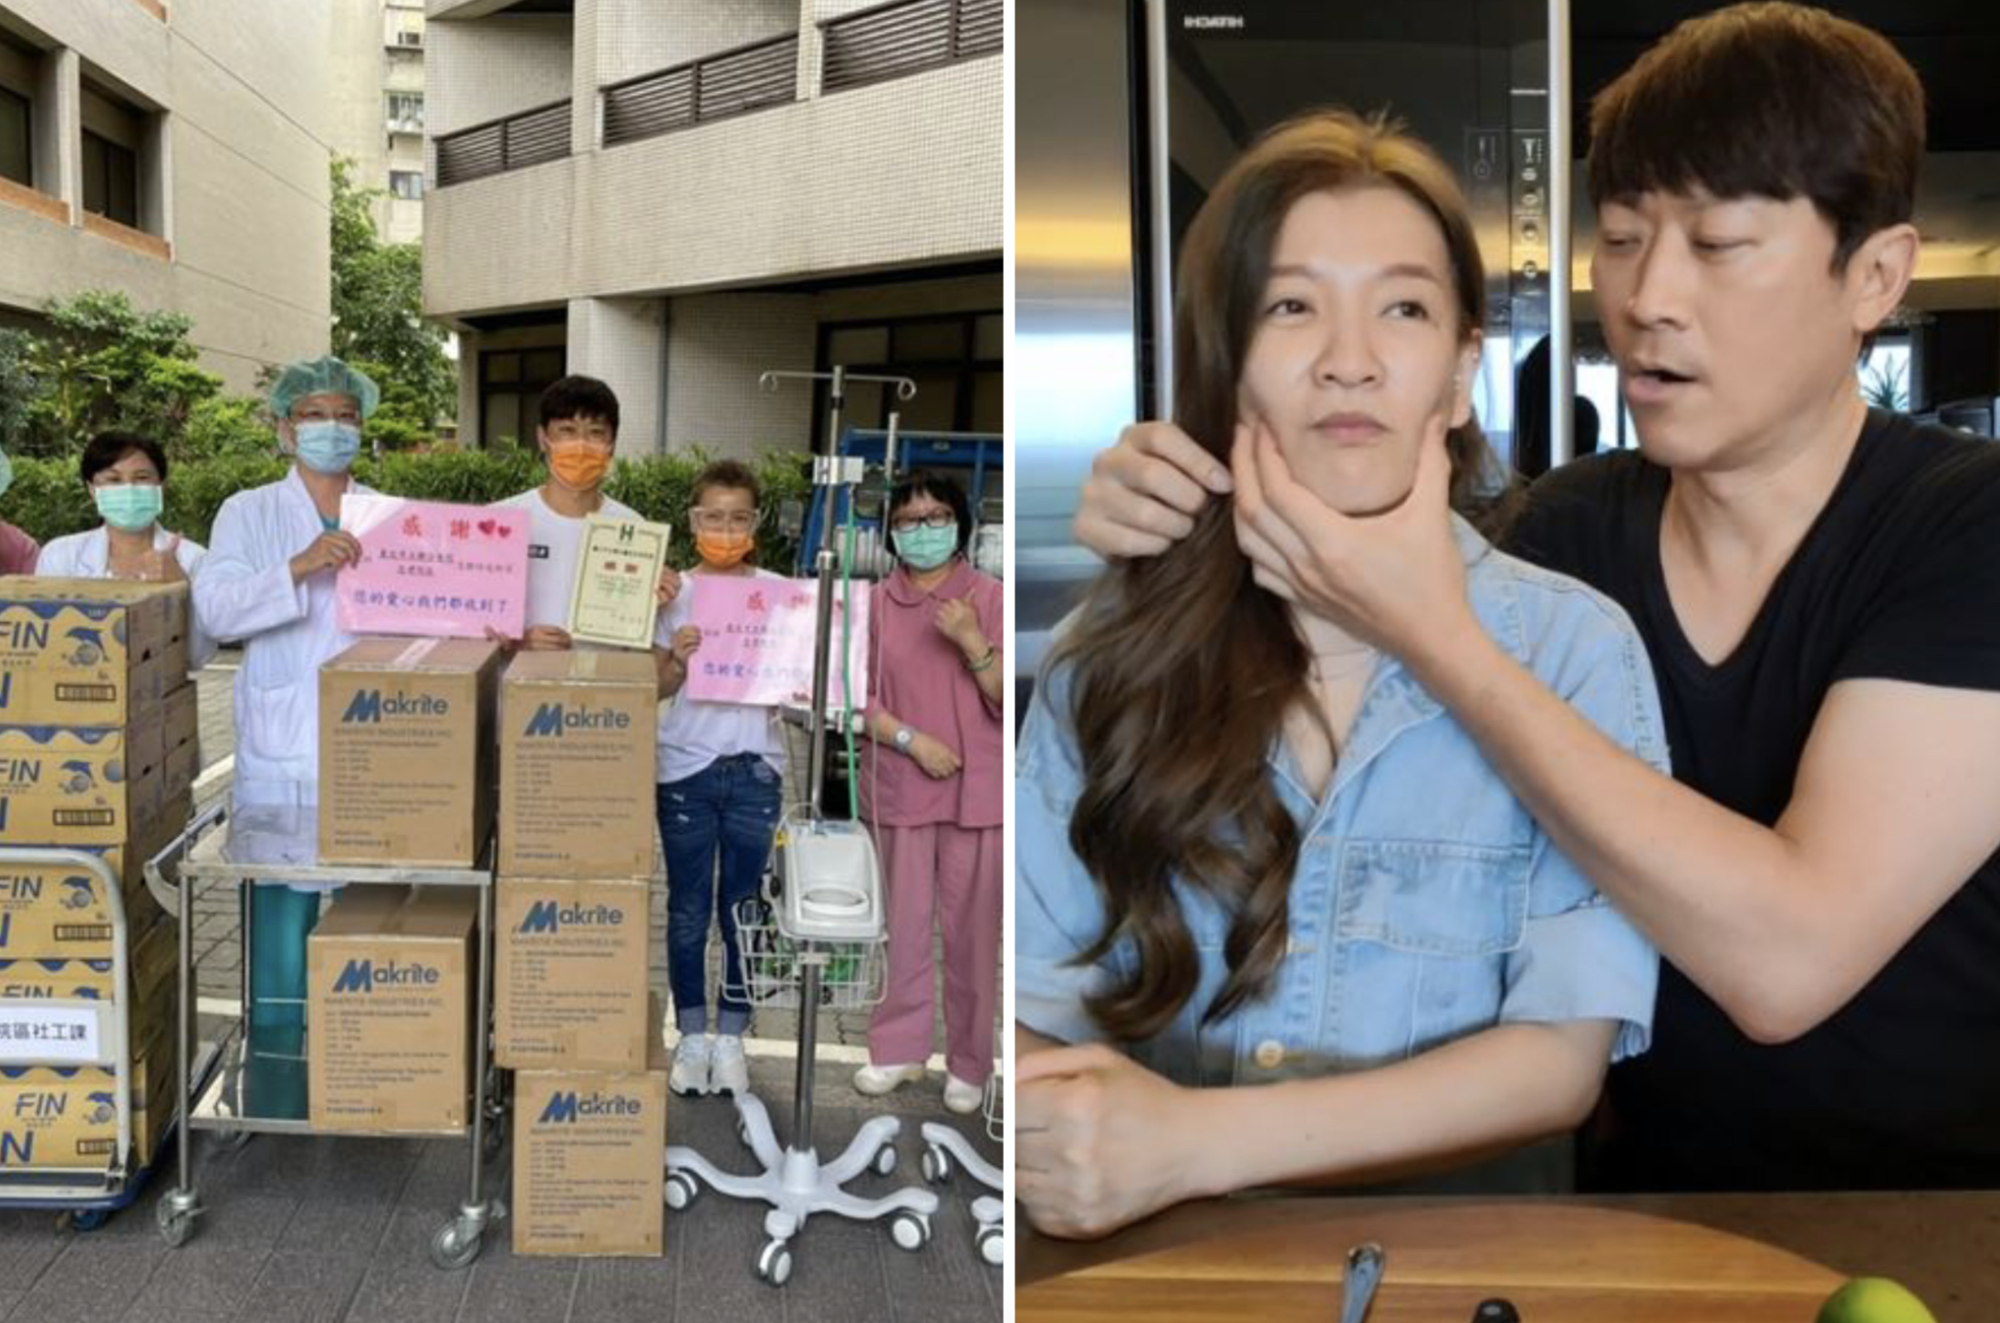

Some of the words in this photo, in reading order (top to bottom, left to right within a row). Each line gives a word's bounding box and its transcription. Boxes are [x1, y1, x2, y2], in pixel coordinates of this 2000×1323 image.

[342, 689, 449, 722] Makrite
[523, 703, 630, 737] Makrite
[518, 901, 623, 934] Makrite
[332, 959, 439, 993] Makrite
[15, 1093, 68, 1117] FIN
[538, 1091, 641, 1123] Makrite
